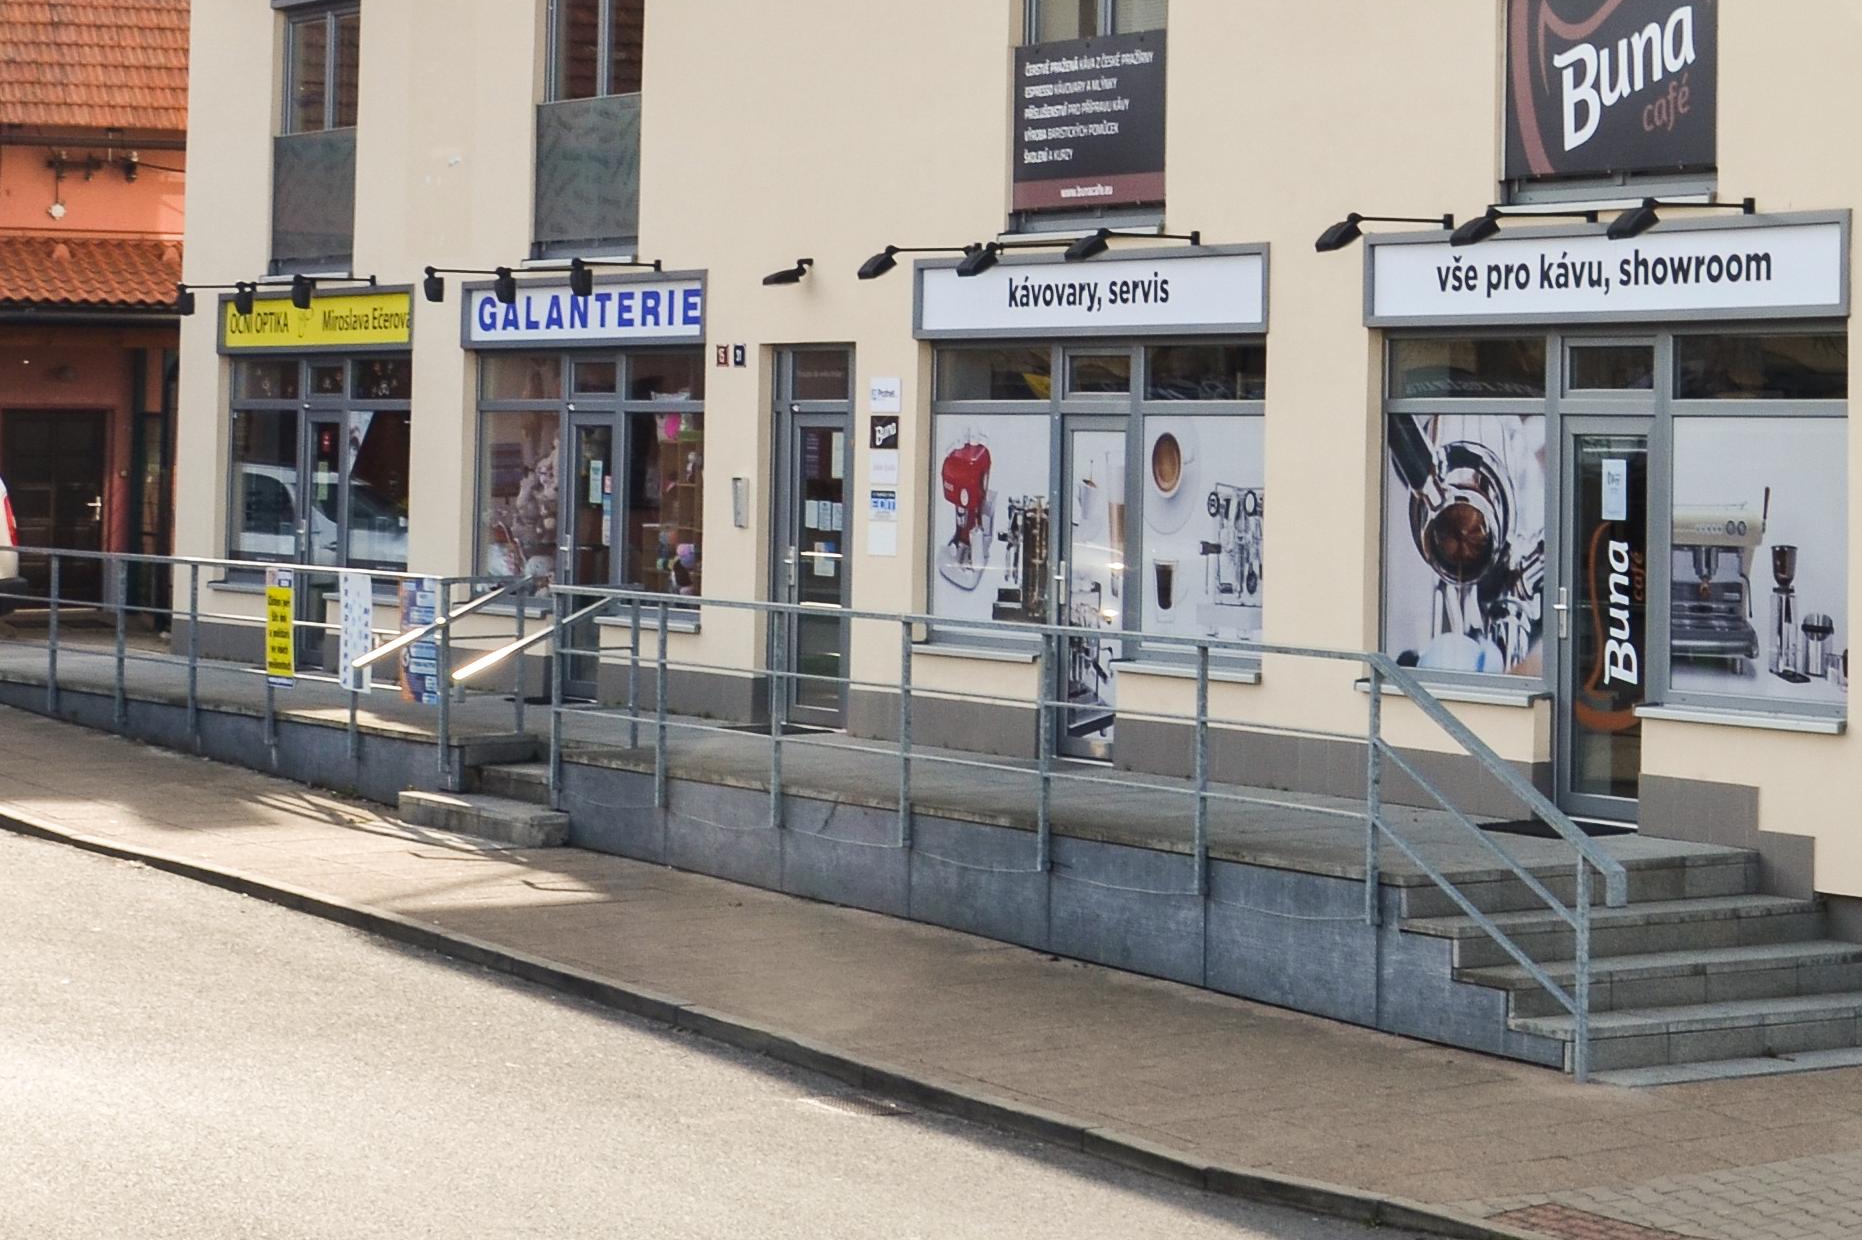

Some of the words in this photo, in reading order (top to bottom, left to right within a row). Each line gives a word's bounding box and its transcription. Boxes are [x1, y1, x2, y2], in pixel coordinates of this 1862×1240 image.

[1553, 5, 1695, 153] Buna
[1642, 71, 1691, 133] café
[1008, 275, 1103, 312] kávovary,
[1108, 271, 1171, 305] servis
[1436, 256, 1479, 293] vše
[1485, 259, 1531, 298] pro
[1539, 251, 1611, 295] kávu,
[1618, 248, 1773, 288] showroom
[256, 311, 289, 334] OPTIKA
[322, 308, 369, 331] Miroslava
[479, 288, 702, 333] GALANTERIE
[1604, 540, 1638, 686] Buna
